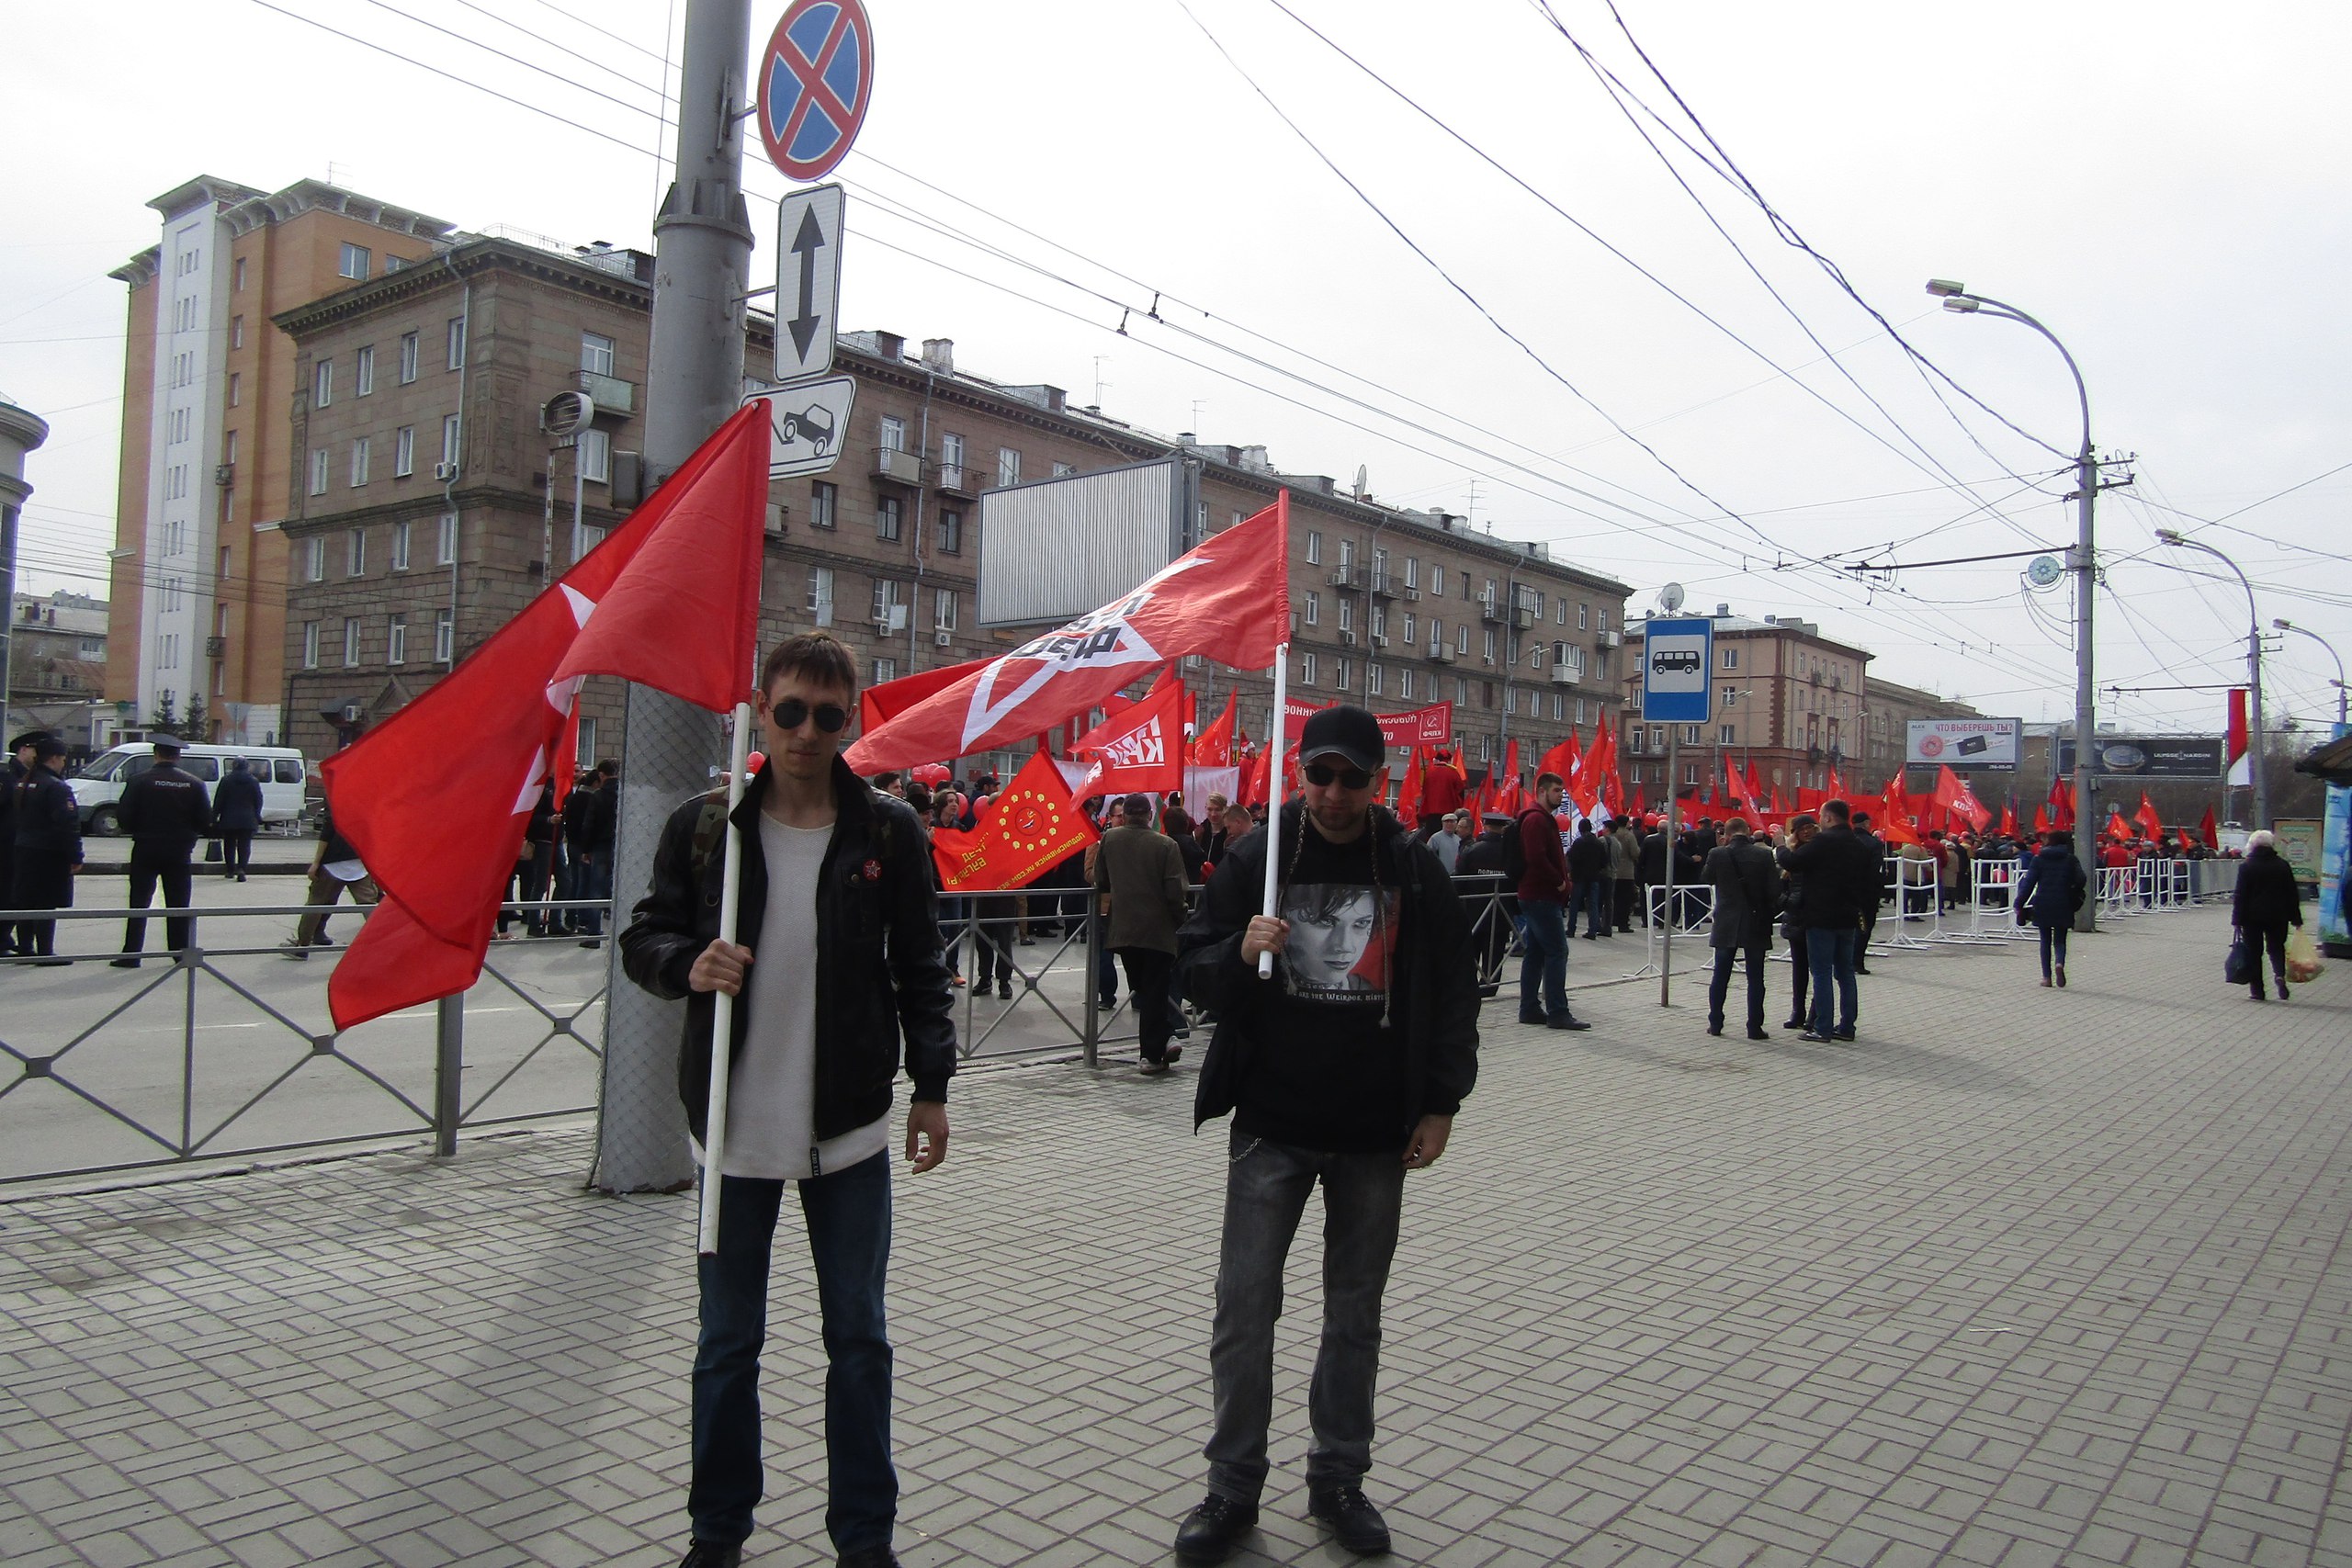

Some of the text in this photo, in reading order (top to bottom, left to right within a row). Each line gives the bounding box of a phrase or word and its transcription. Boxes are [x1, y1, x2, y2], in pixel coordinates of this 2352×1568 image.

[1936, 723, 2013, 732] ЧТО ВЫБЕРЕШЬ ТЫ?
[154, 780, 191, 789] ПОЛИЦИЯ
